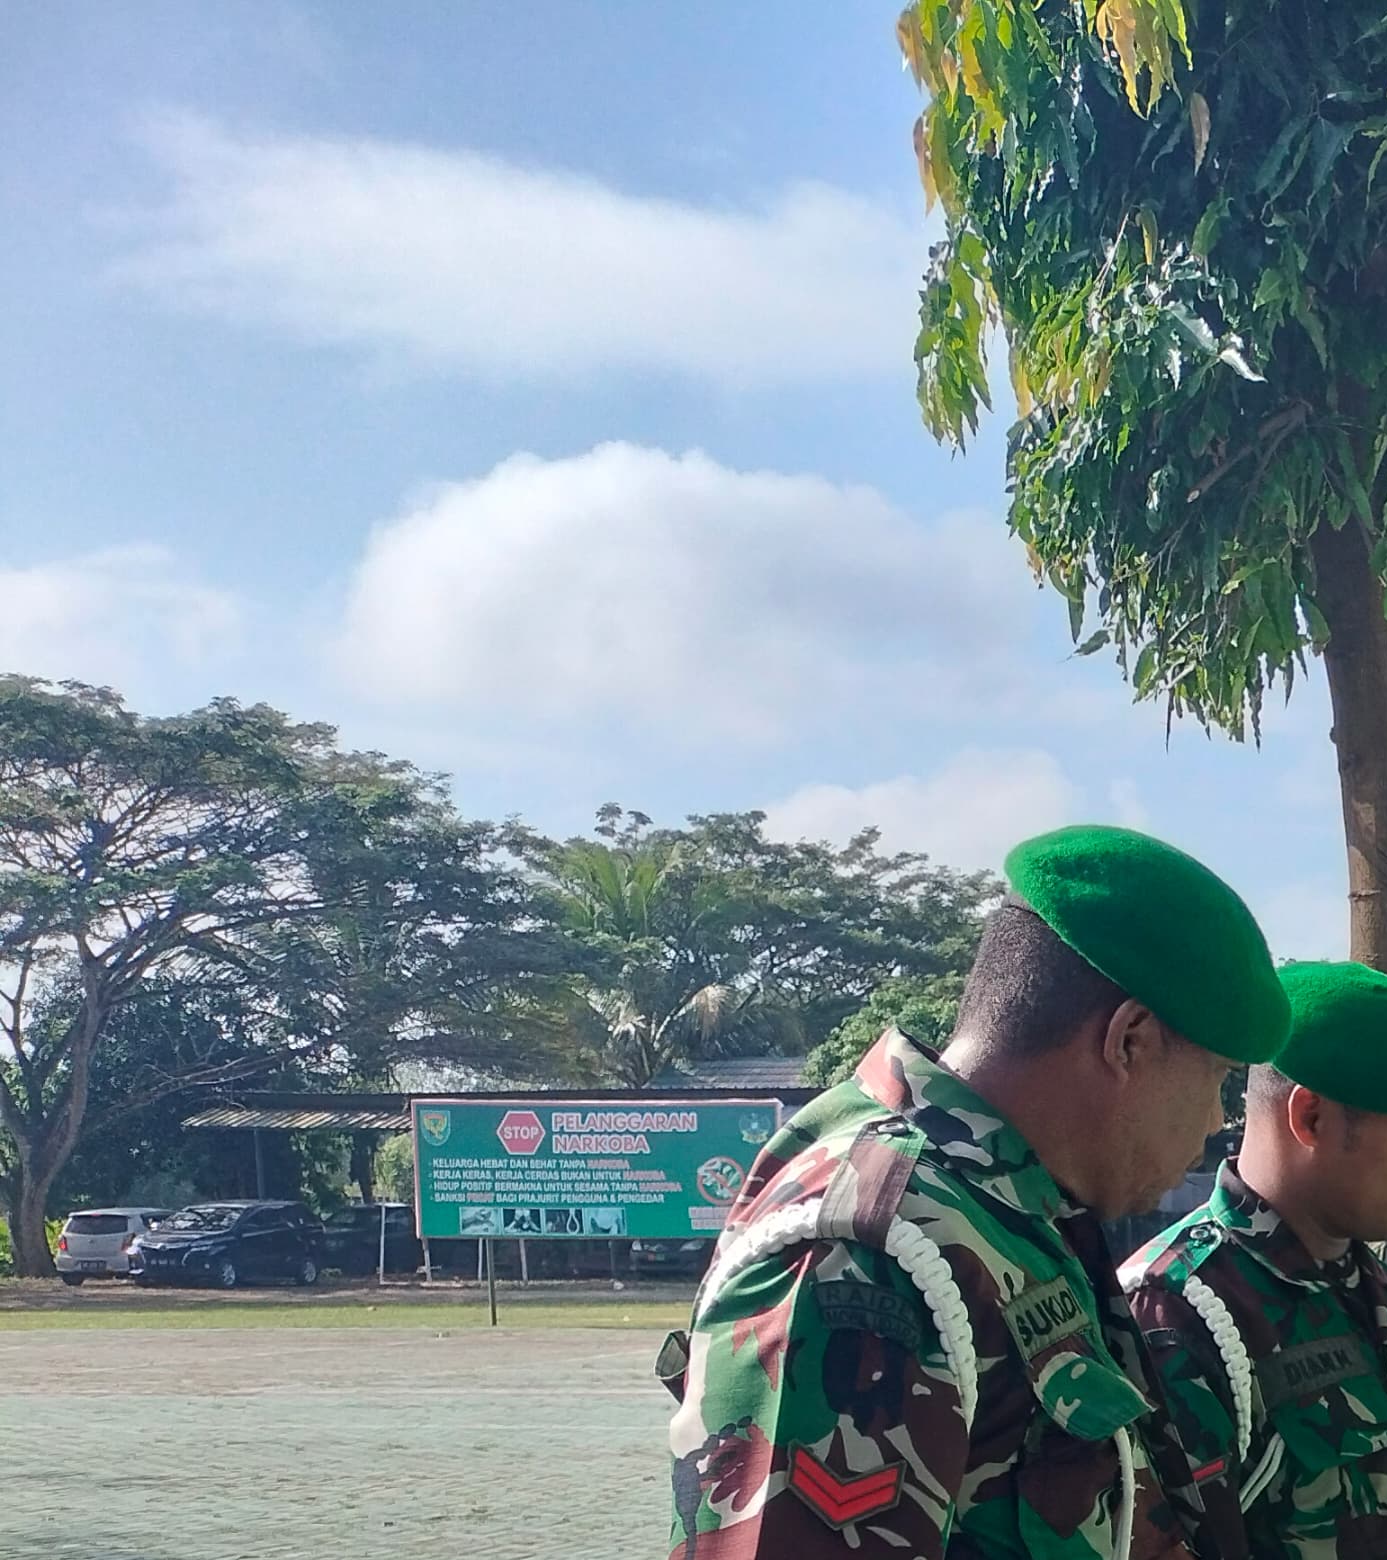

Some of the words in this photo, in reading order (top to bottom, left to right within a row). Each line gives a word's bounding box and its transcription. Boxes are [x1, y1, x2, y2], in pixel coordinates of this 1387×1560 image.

[551, 1112, 698, 1133] PELANGGARAN
[503, 1125, 539, 1140] STOP
[552, 1134, 651, 1154] NARKOBA
[432, 1158, 479, 1169] KELUARGA
[480, 1158, 508, 1169] HEBAT
[510, 1159, 528, 1169] DAN
[558, 1159, 586, 1169] TANPA
[433, 1170, 461, 1181] KERJA
[495, 1170, 523, 1180] KERJA
[524, 1171, 559, 1181] CERDAS
[561, 1171, 591, 1181] BUKAN
[592, 1171, 622, 1181] UNTUK
[434, 1182, 460, 1192] HIDUP
[461, 1182, 493, 1192] POSITIF
[543, 1182, 573, 1192] UNTUK
[611, 1182, 638, 1192] TANPA
